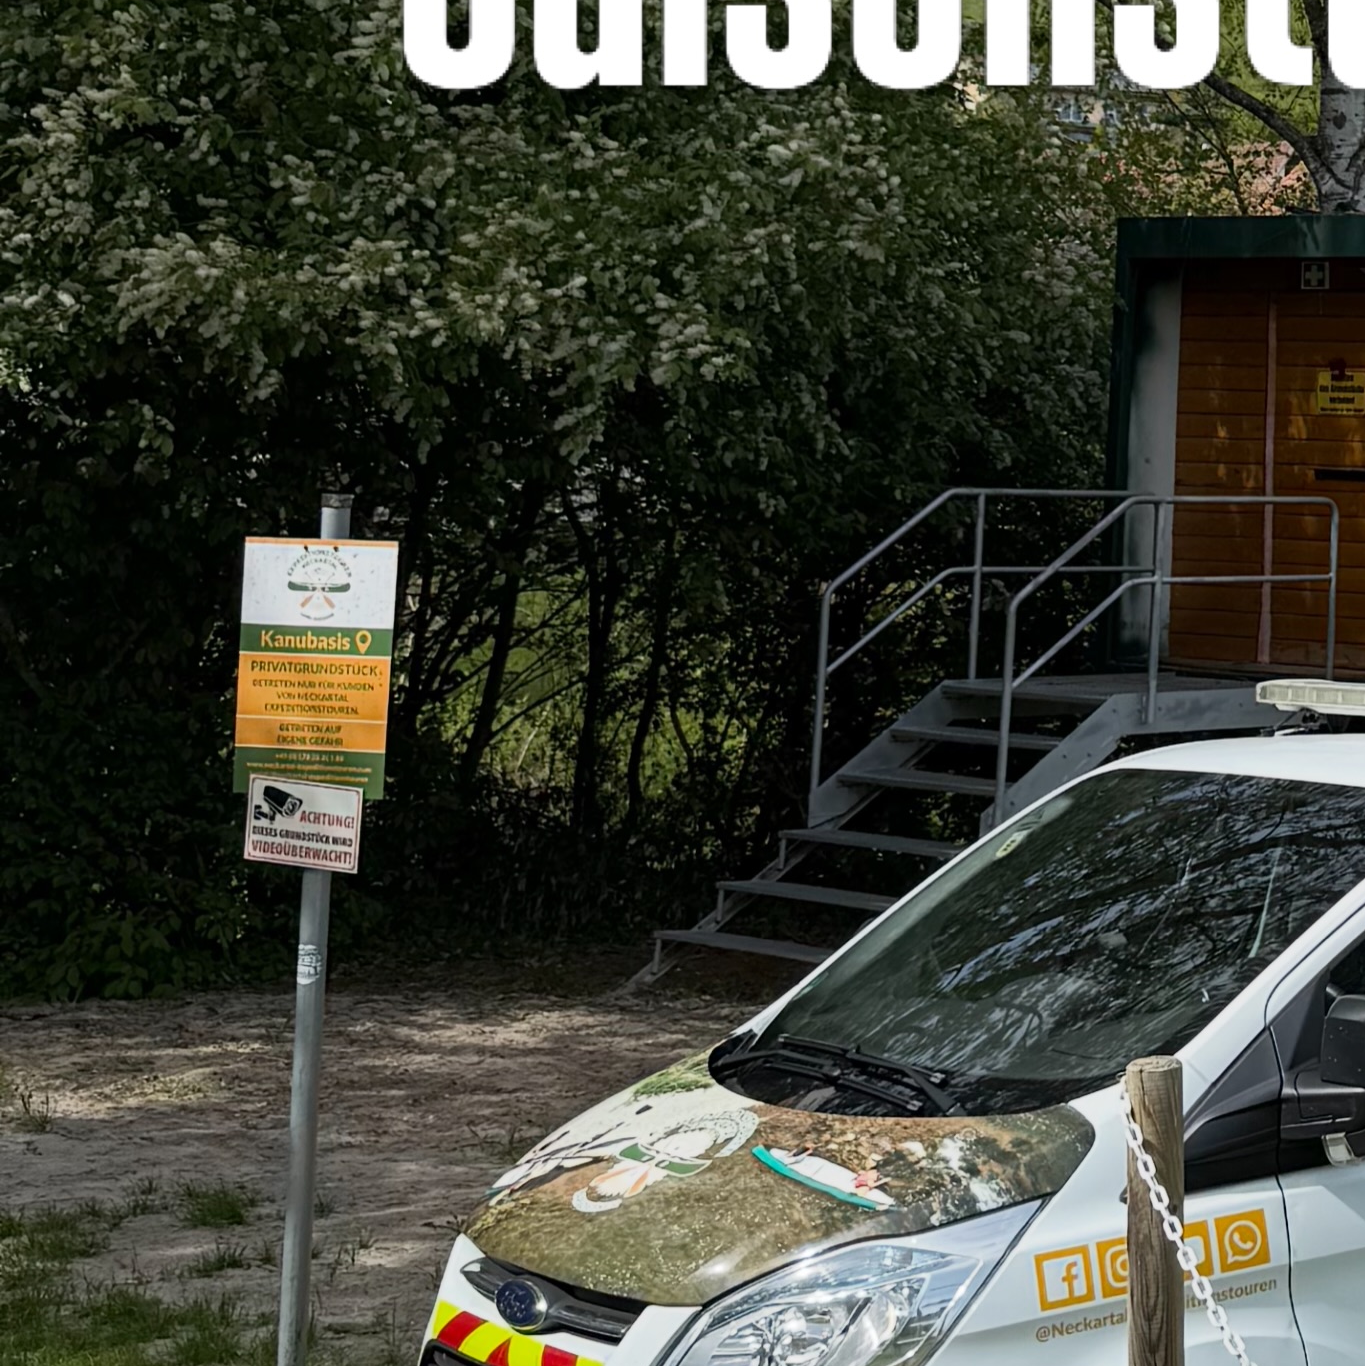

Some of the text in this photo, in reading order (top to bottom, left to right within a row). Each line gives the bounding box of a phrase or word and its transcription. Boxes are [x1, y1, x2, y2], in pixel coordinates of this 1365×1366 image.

[261, 630, 350, 651] Kanubasis
[251, 660, 378, 677] PRIVATGRUNDSTÜCK
[300, 810, 354, 829] ACHTUNG!
[252, 825, 353, 847] DIESES GRUNDSTÜCK WIRD
[251, 839, 353, 865] VIDEOÜBERWACHT!
